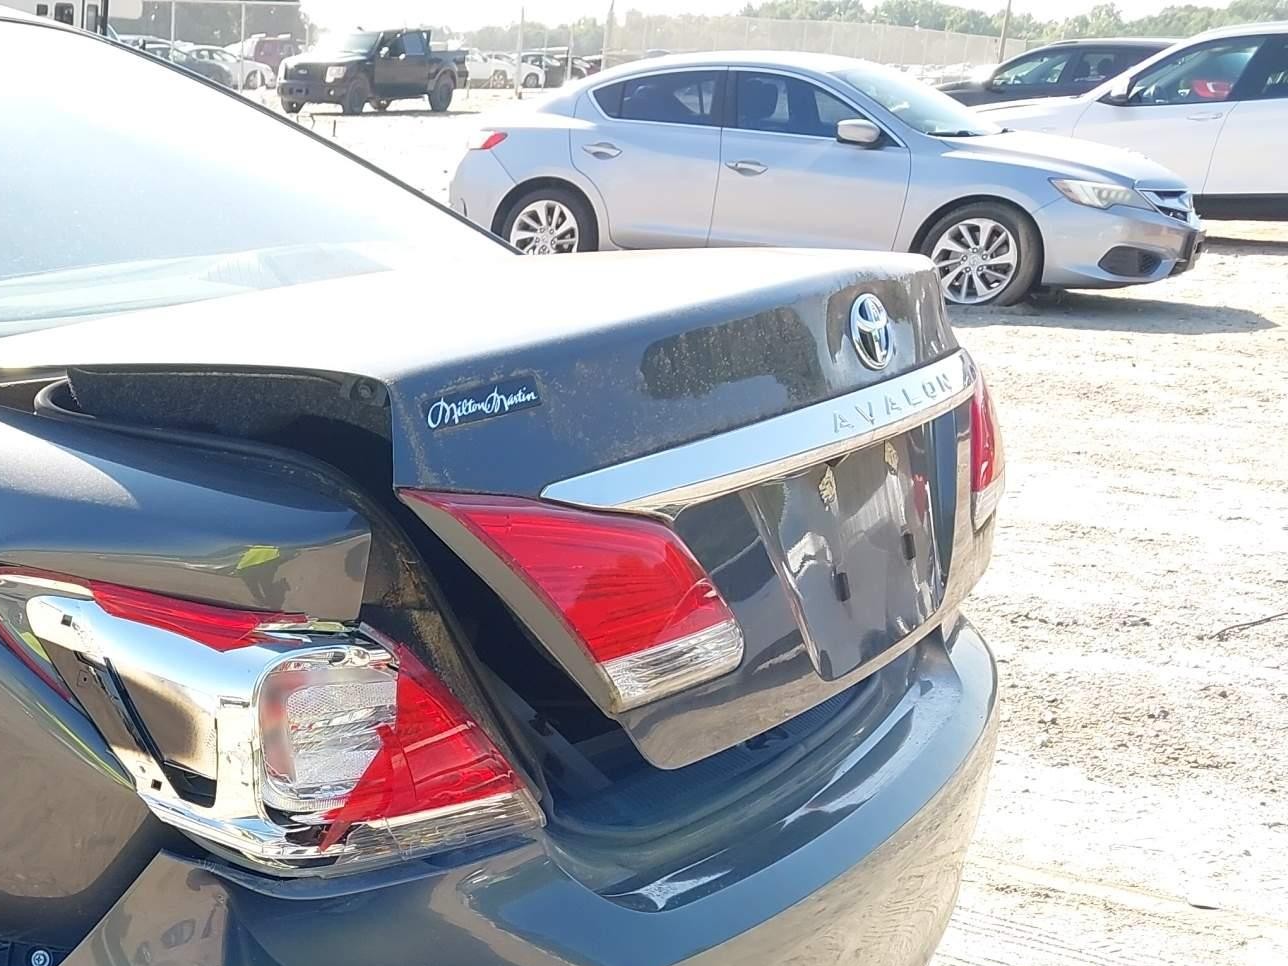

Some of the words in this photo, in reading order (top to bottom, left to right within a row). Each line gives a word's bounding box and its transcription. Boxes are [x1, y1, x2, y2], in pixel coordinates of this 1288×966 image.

[427, 396, 486, 429] Milton
[485, 385, 539, 414] Martin
[833, 373, 953, 434] AVALON
